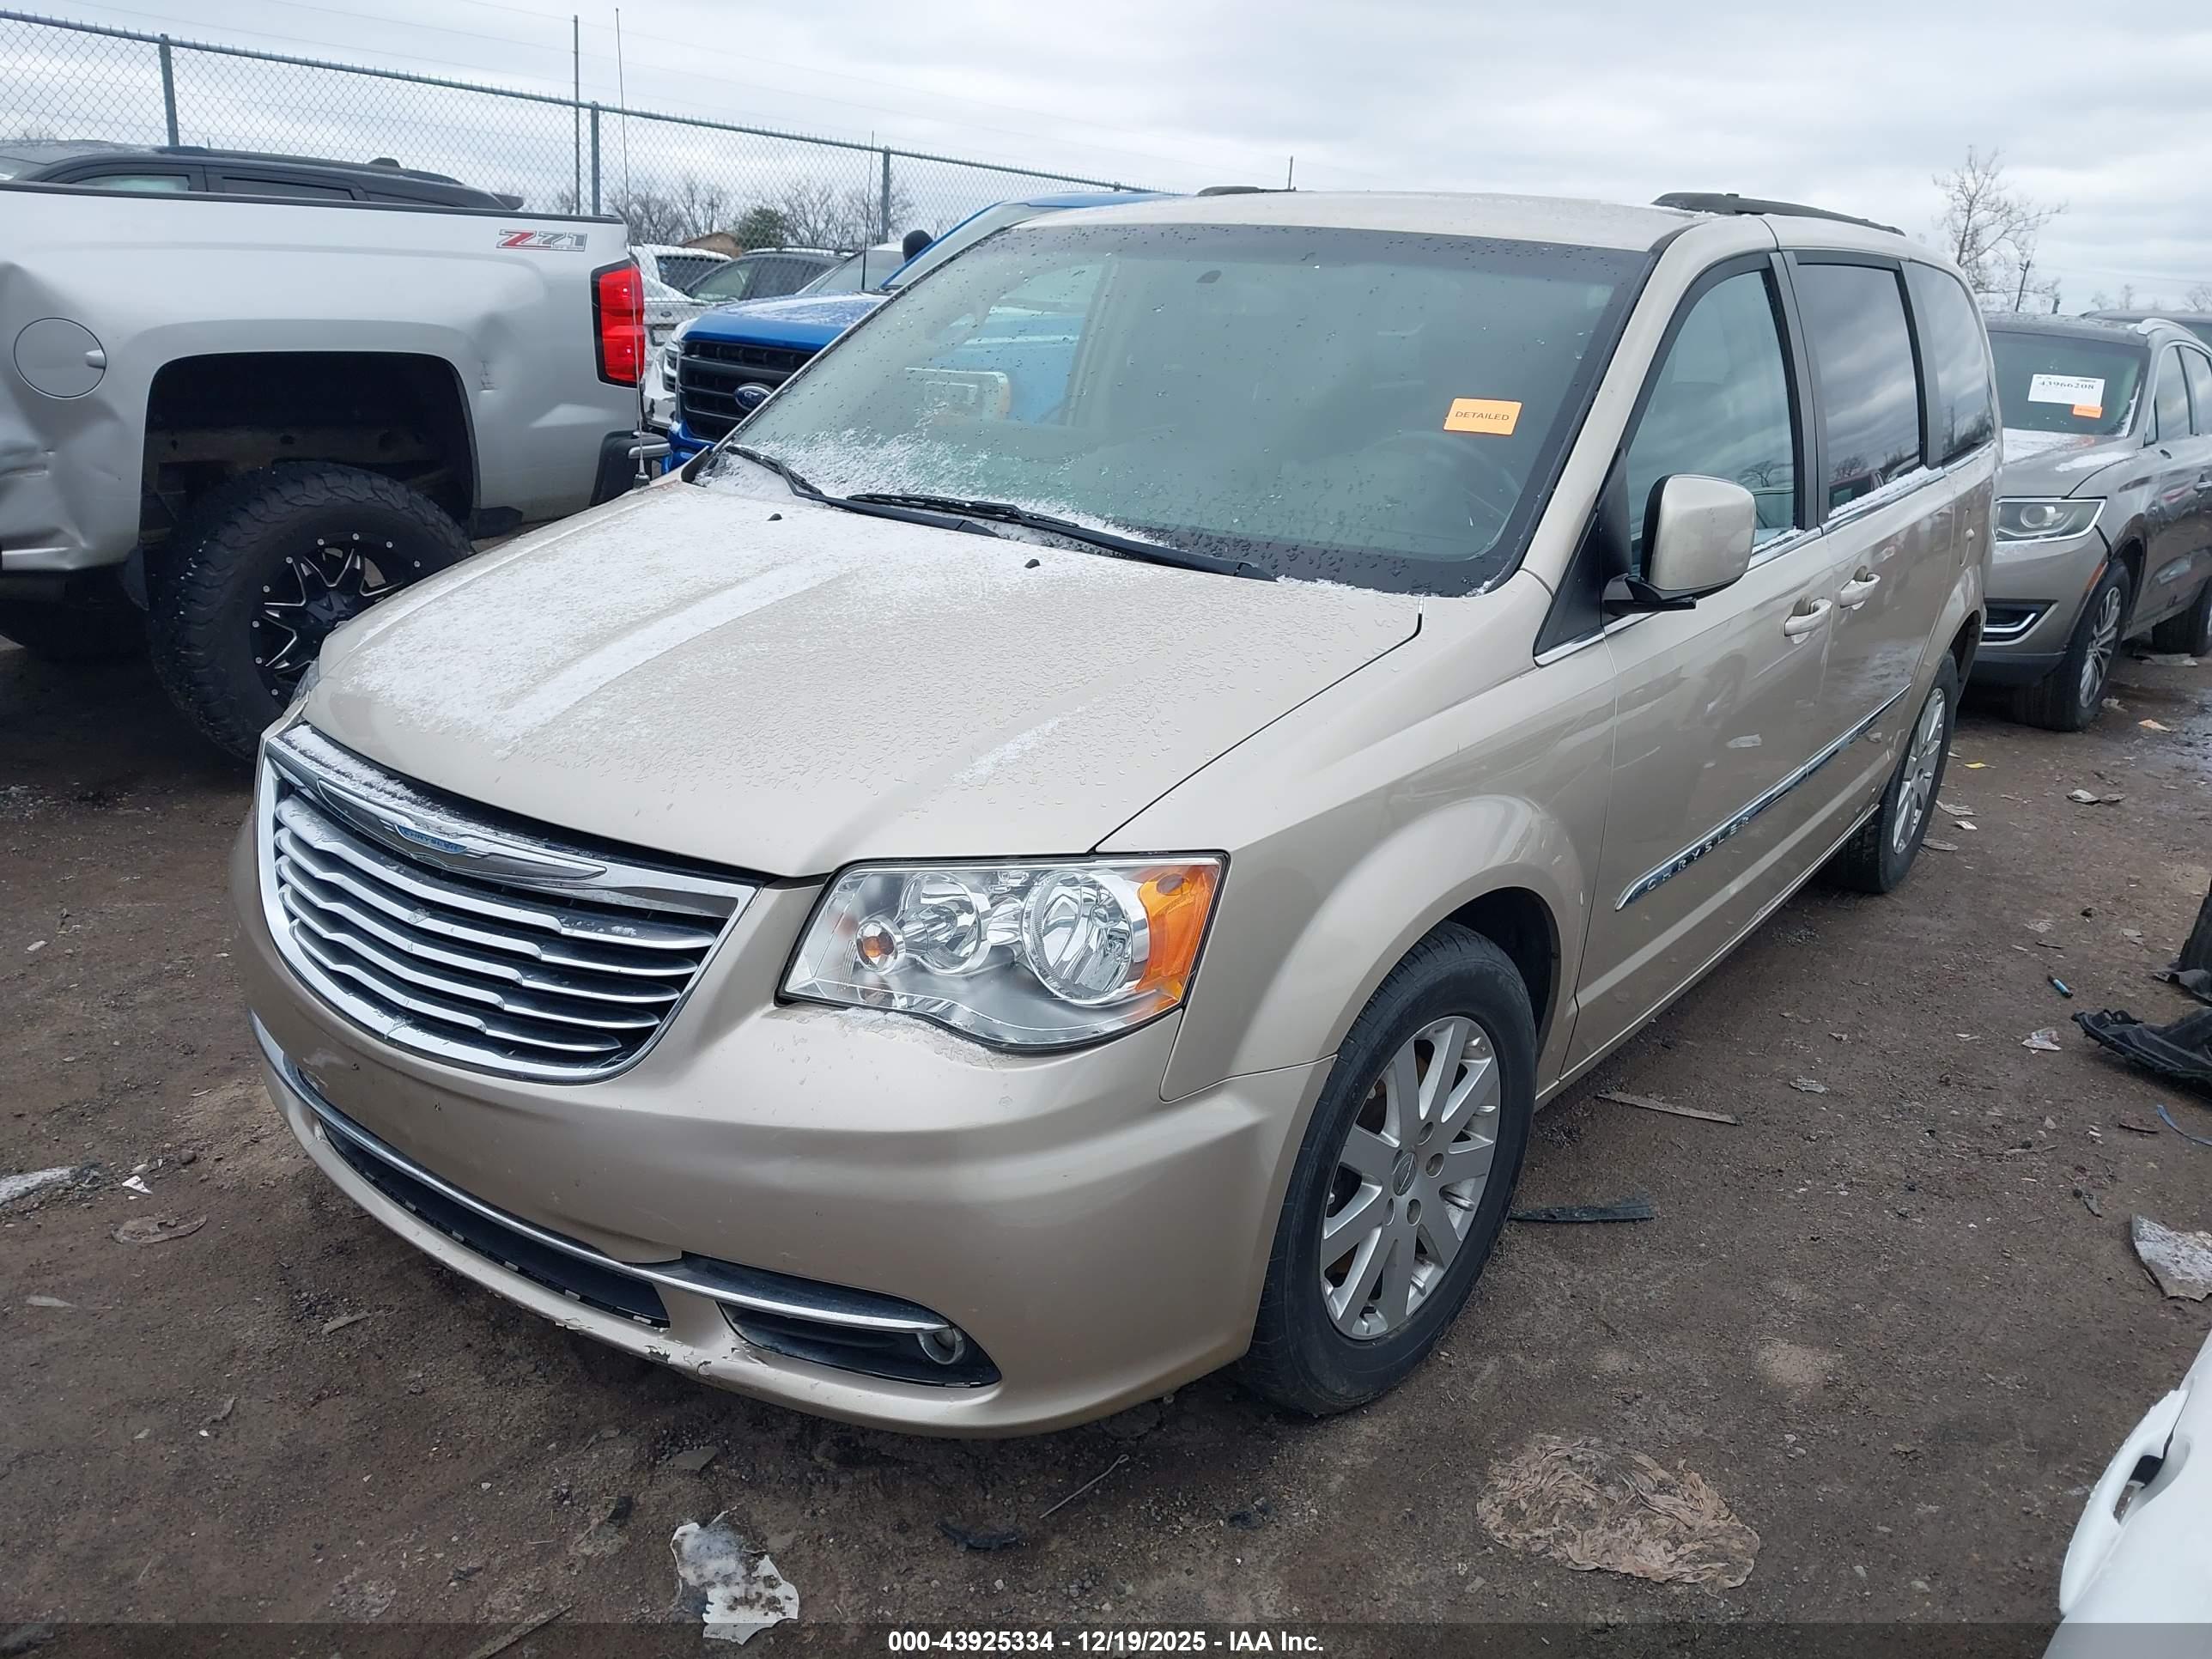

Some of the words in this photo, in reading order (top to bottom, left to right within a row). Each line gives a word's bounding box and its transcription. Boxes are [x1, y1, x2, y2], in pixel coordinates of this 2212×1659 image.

[495, 228, 588, 252] Z71
[1455, 410, 1510, 421] DETAILED
[1646, 816, 1751, 890] CHRYSLER
